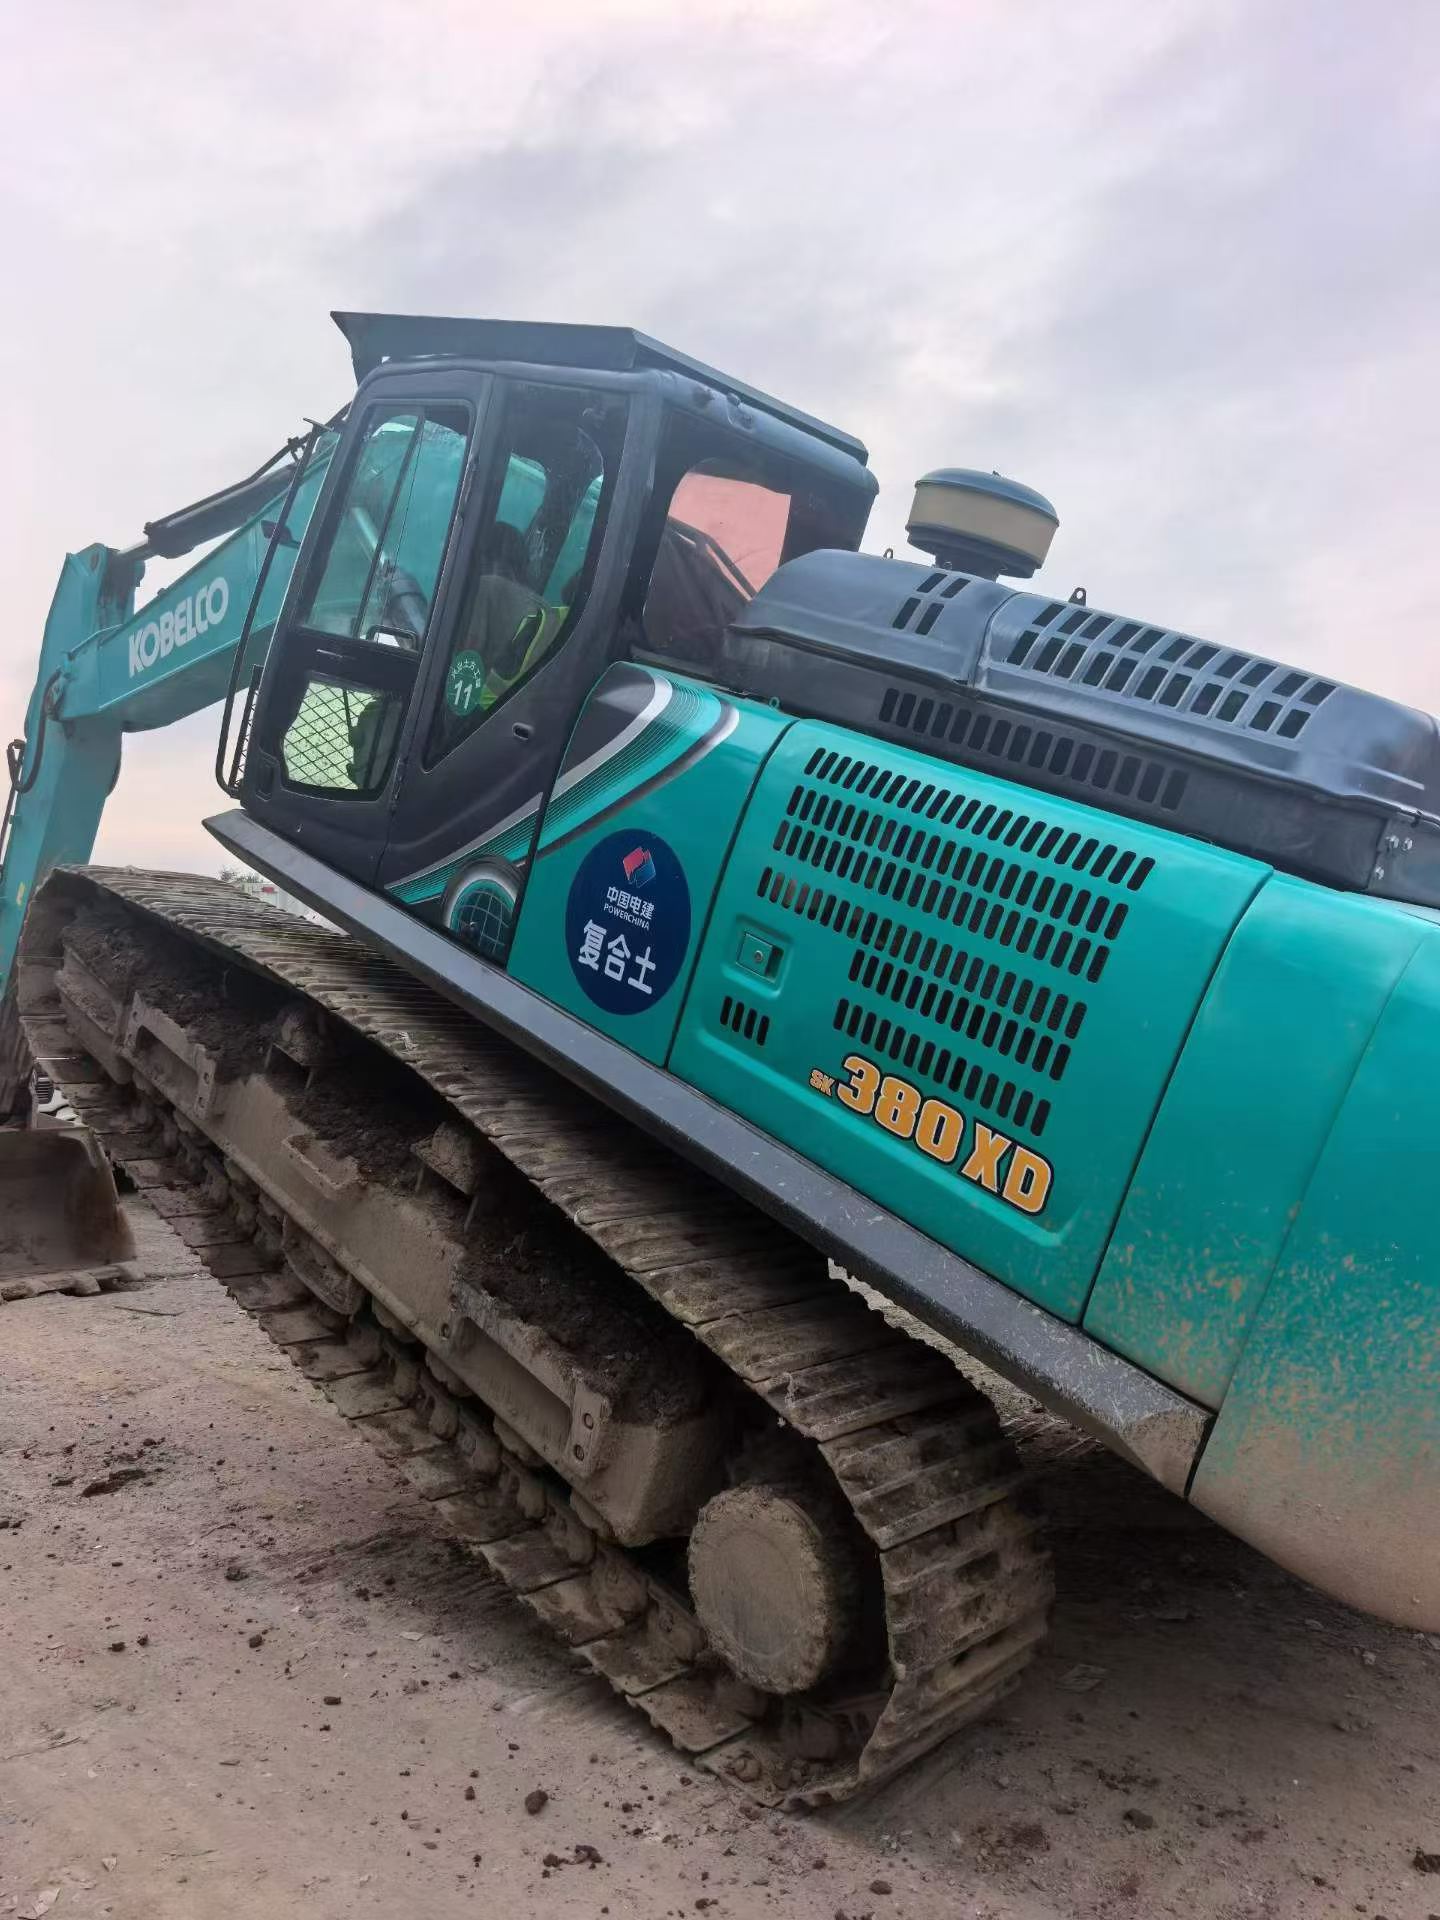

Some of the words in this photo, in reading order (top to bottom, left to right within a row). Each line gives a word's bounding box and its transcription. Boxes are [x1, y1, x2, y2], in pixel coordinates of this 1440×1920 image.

[128, 576, 229, 678] KOBELCO
[453, 679, 473, 710] 11
[603, 903, 651, 931] POWERCHINA
[606, 886, 655, 920] 中国电建
[577, 919, 656, 995] 复合土
